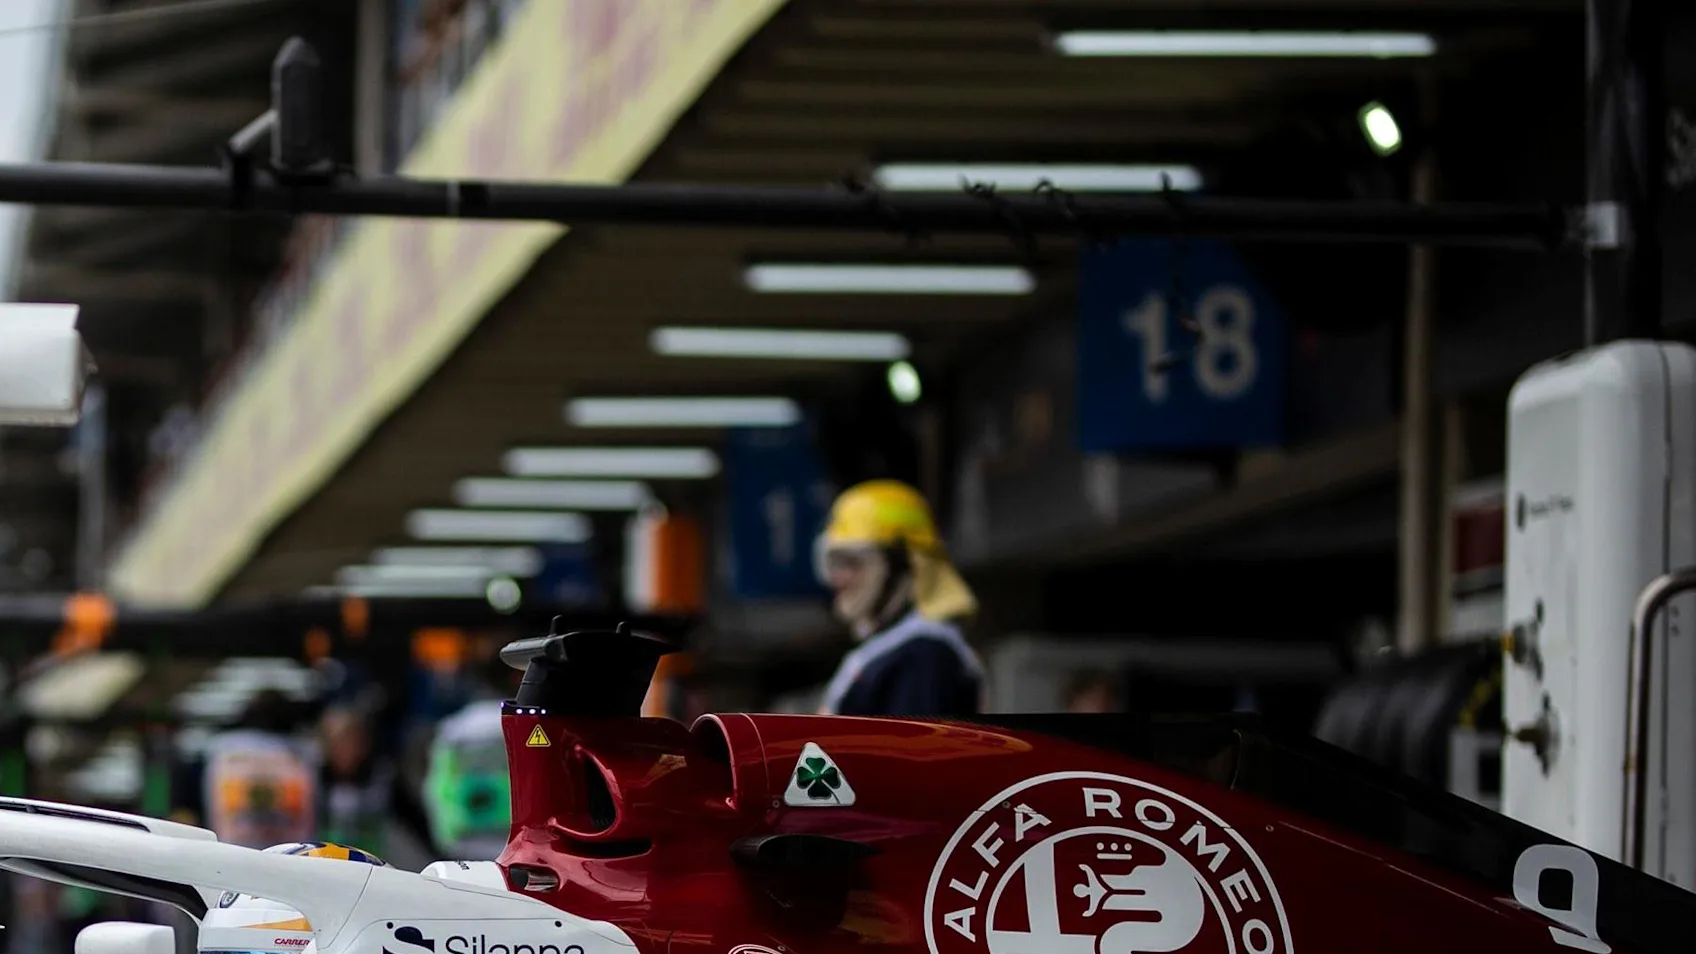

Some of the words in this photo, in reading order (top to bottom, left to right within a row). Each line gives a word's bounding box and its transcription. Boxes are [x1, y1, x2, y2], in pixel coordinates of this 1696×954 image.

[1122, 288, 1257, 402] 18
[944, 803, 1052, 942] ALFA
[1512, 843, 1612, 954] 9
[274, 938, 310, 946] CARRER
